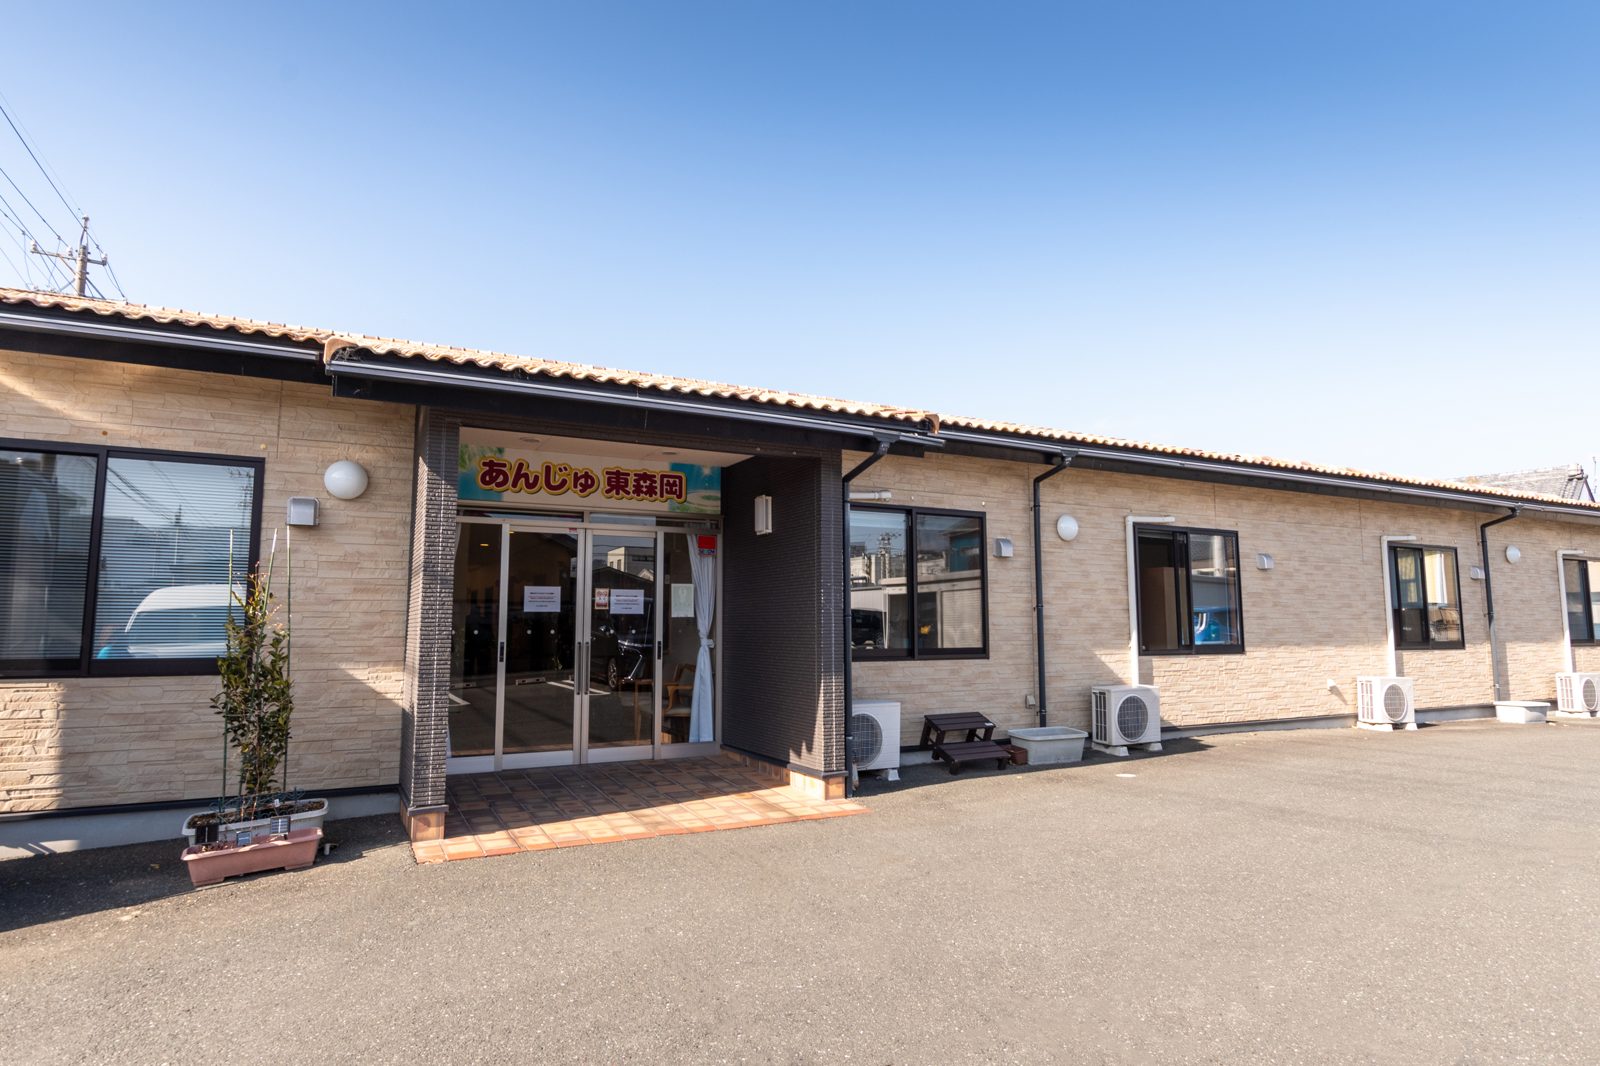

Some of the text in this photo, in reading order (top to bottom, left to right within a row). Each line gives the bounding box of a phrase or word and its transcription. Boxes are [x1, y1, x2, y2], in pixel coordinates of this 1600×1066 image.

[479, 459, 684, 500] あんじゅ 東森岡
